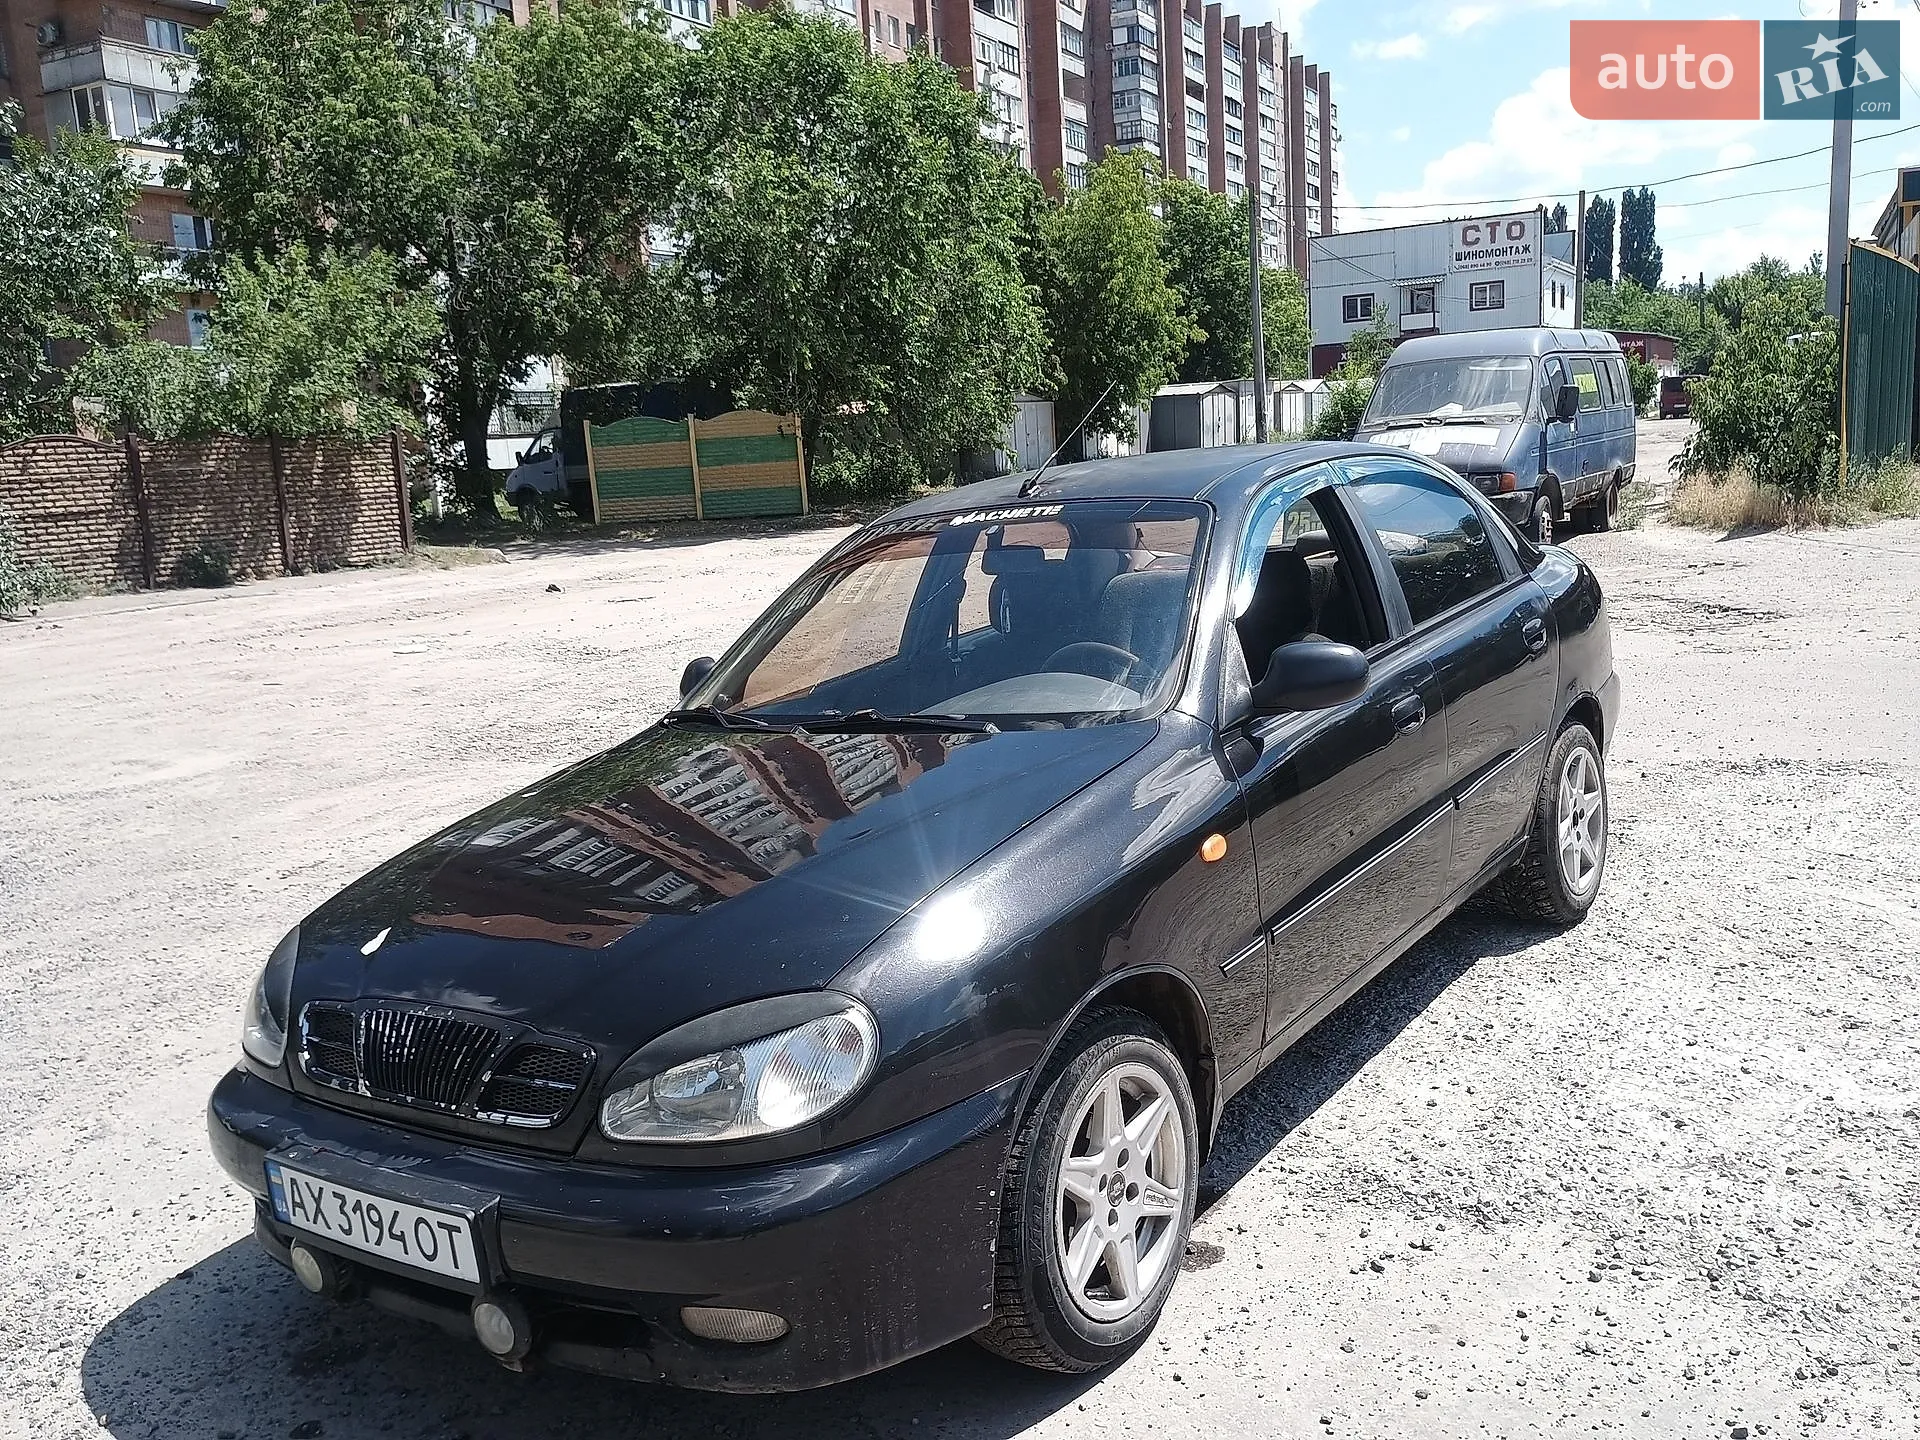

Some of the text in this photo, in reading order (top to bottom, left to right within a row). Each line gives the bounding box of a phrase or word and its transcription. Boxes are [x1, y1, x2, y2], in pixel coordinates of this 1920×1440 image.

[1461, 220, 1526, 247] СТО
[1454, 243, 1532, 262] ШИНОМОНТАЖ
[1620, 339, 1644, 349] НТАЖ
[274, 1198, 288, 1214] UA
